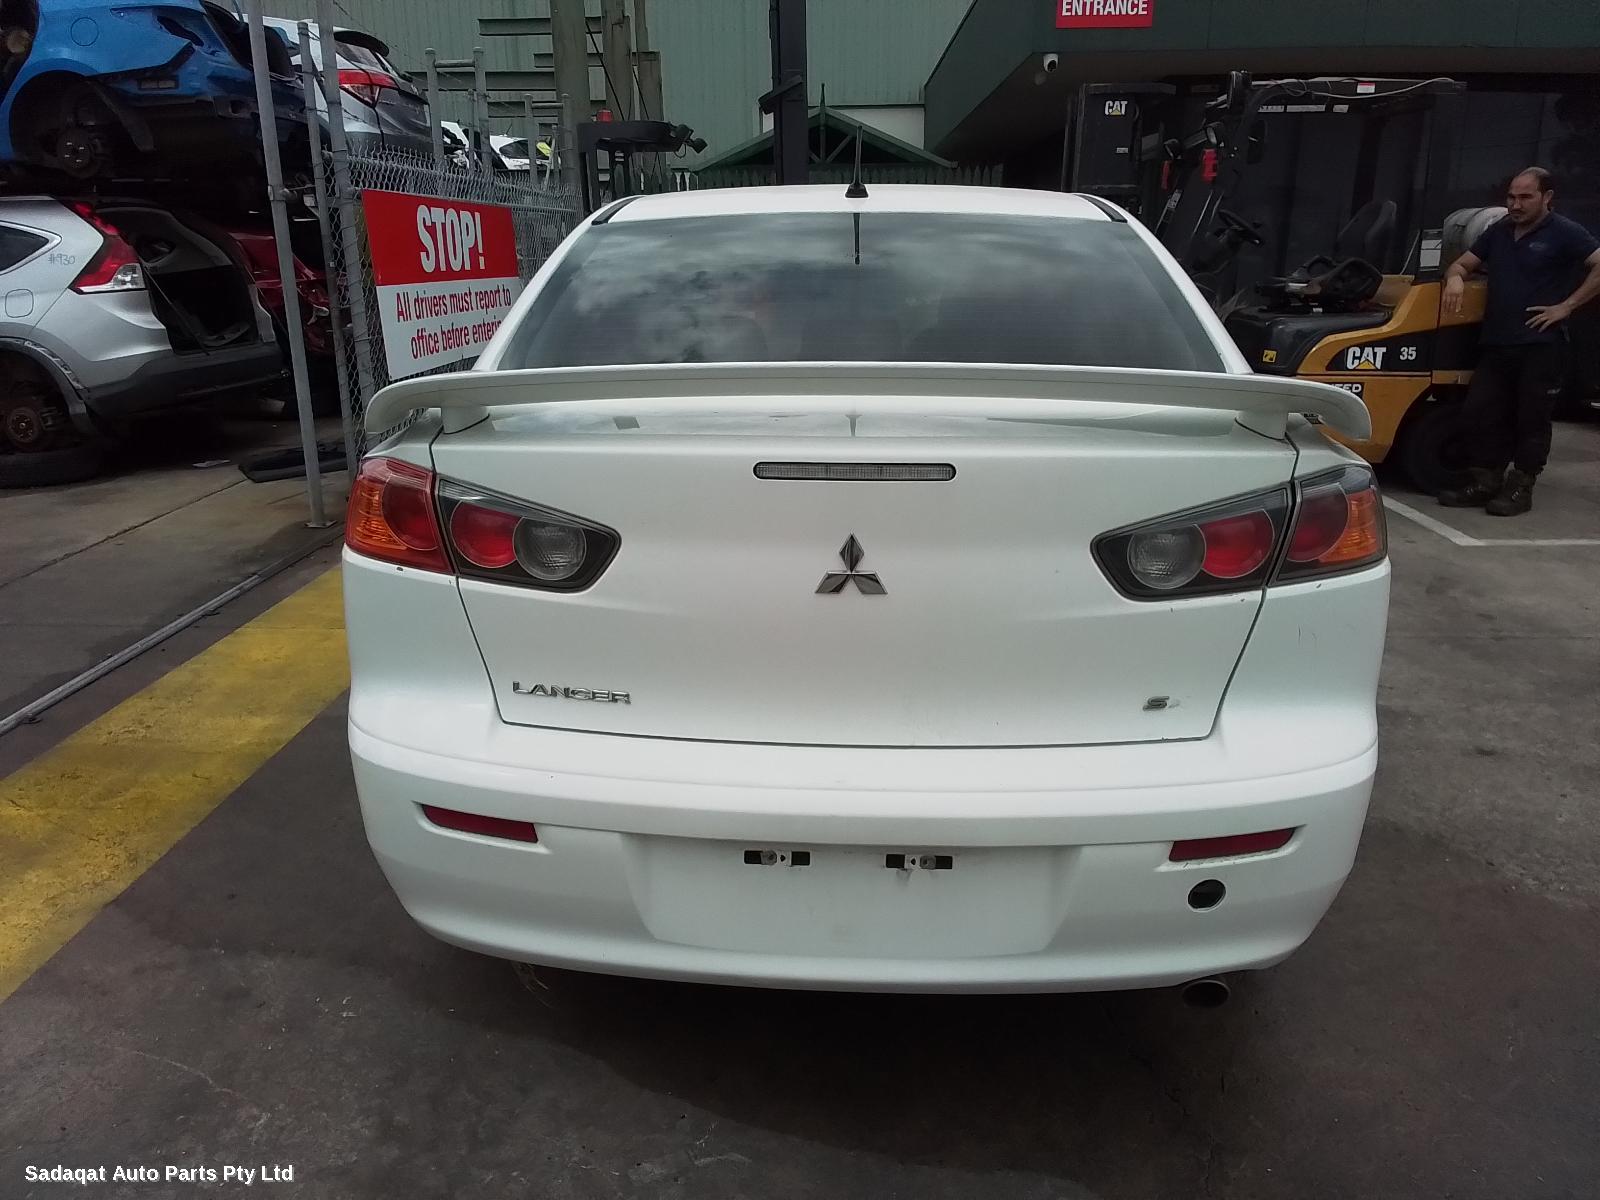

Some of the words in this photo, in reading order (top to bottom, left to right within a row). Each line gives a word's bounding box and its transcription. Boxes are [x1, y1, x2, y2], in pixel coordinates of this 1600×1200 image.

[1062, 0, 1148, 16] ENTRANCE
[1104, 100, 1128, 115] CAT
[416, 204, 485, 273] STOP!
[396, 291, 412, 322] All
[414, 290, 448, 320] drivers
[449, 287, 474, 314] must
[475, 284, 502, 314] report
[502, 284, 512, 307] to
[410, 327, 440, 359] office
[440, 322, 470, 351] before
[1346, 346, 1387, 370] CAT
[1400, 346, 1417, 361] 35
[512, 681, 631, 704] LANCER
[1142, 695, 1170, 711] S
